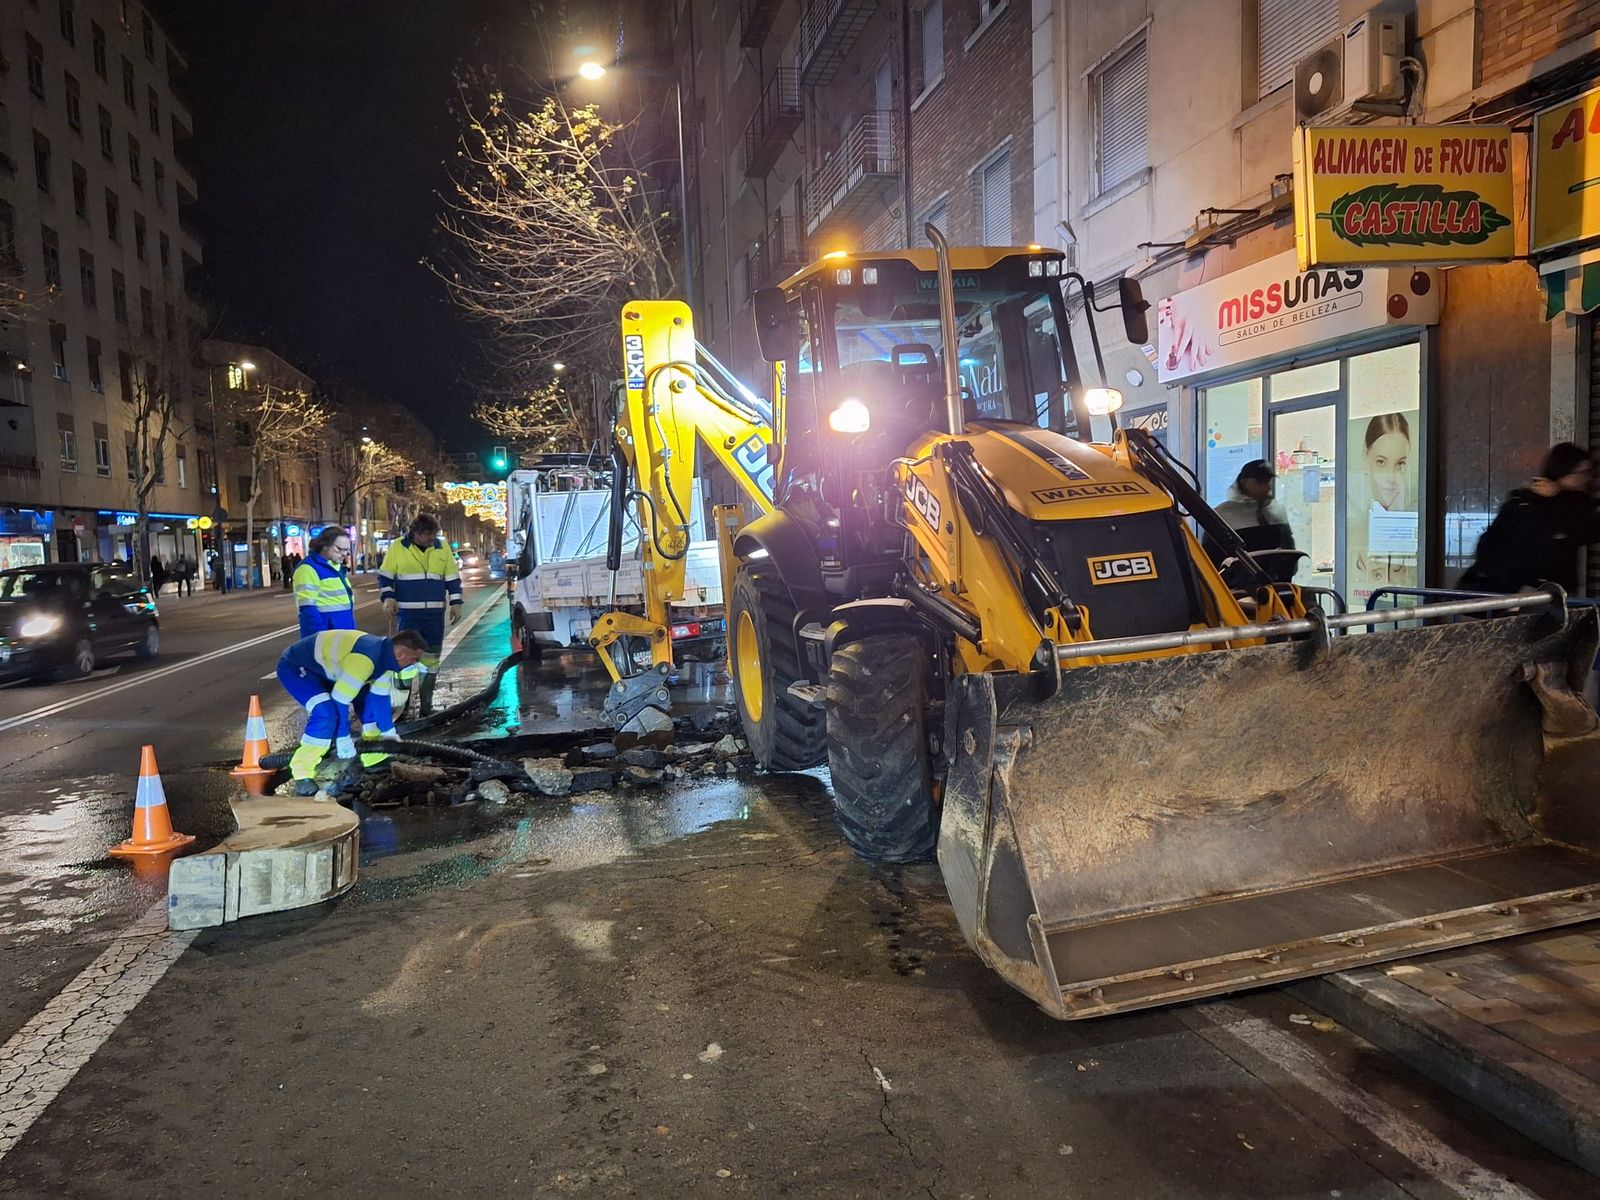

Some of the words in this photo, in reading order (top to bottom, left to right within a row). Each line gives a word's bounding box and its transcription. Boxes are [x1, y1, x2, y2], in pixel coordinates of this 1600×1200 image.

[1314, 138, 1408, 174] ALMACEN
[1414, 146, 1433, 174] DE
[1440, 138, 1509, 176] FRUTAS
[1343, 201, 1482, 235] CASTILLA
[1236, 323, 1266, 339] SALON
[1273, 318, 1285, 328] DE
[1292, 302, 1338, 322] BELLEZA
[626, 336, 645, 377] 3CX
[905, 475, 941, 532] JCB
[1042, 482, 1140, 501] WALKIA
[1096, 557, 1151, 579] JCB
